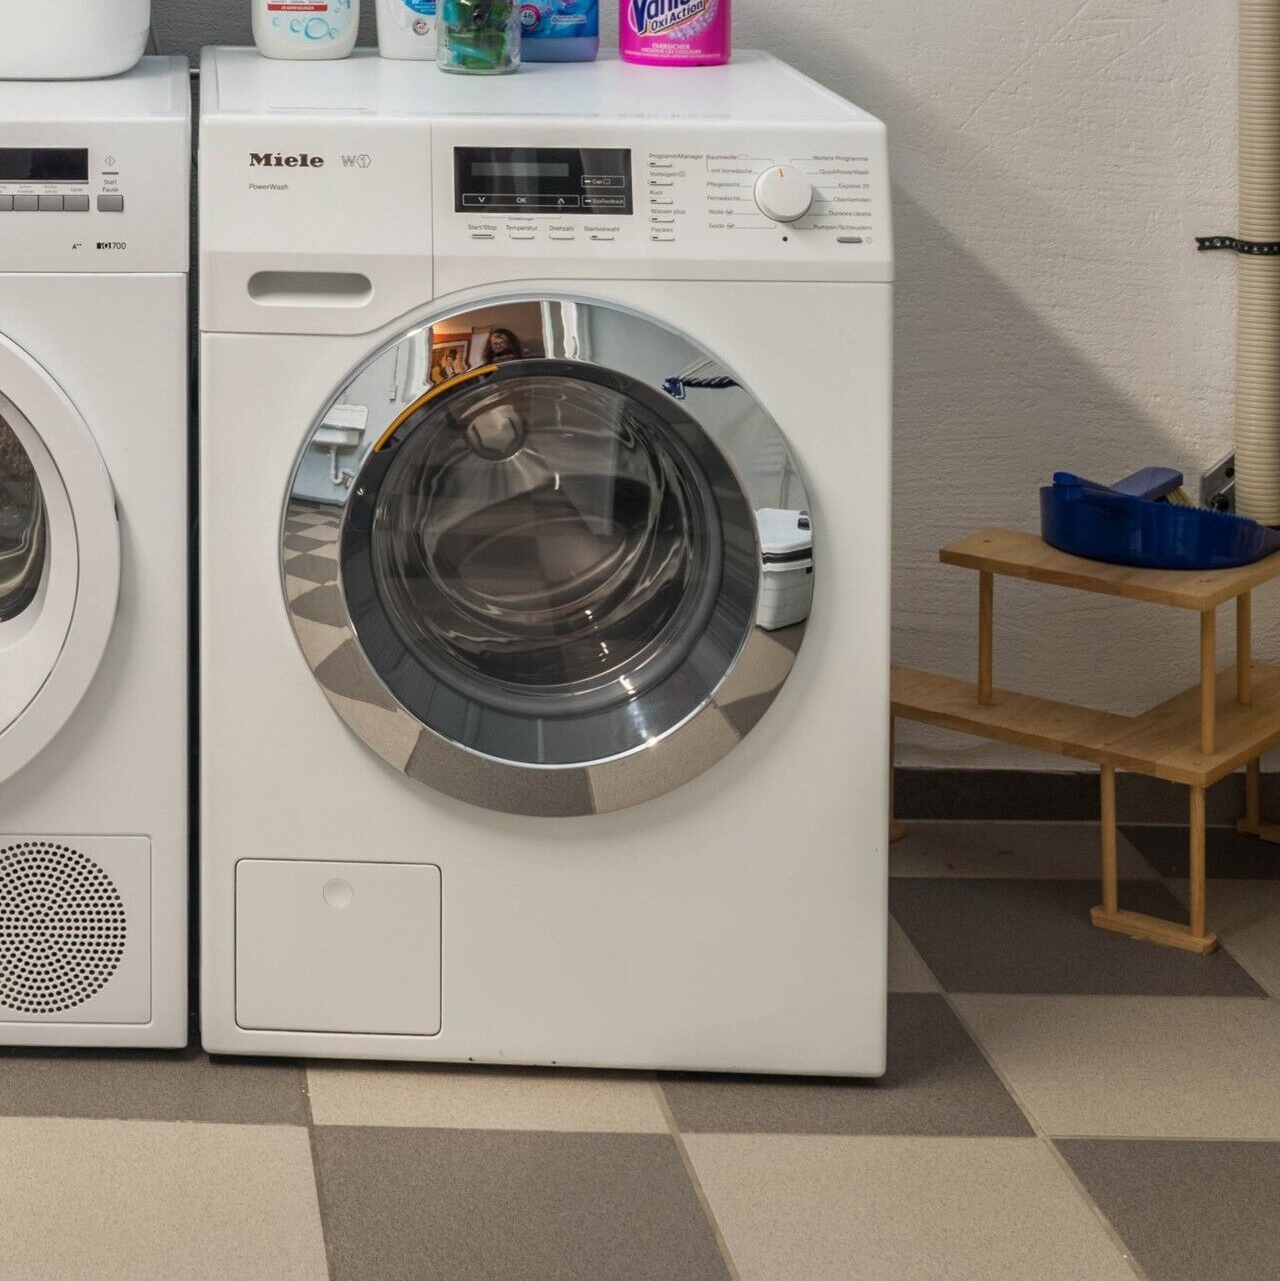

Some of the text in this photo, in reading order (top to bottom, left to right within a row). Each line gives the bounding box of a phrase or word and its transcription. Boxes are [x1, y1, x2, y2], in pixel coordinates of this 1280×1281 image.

[651, 0, 703, 32] Oxi Action
[249, 153, 325, 168] Miele
[248, 183, 289, 191] PowerWash
